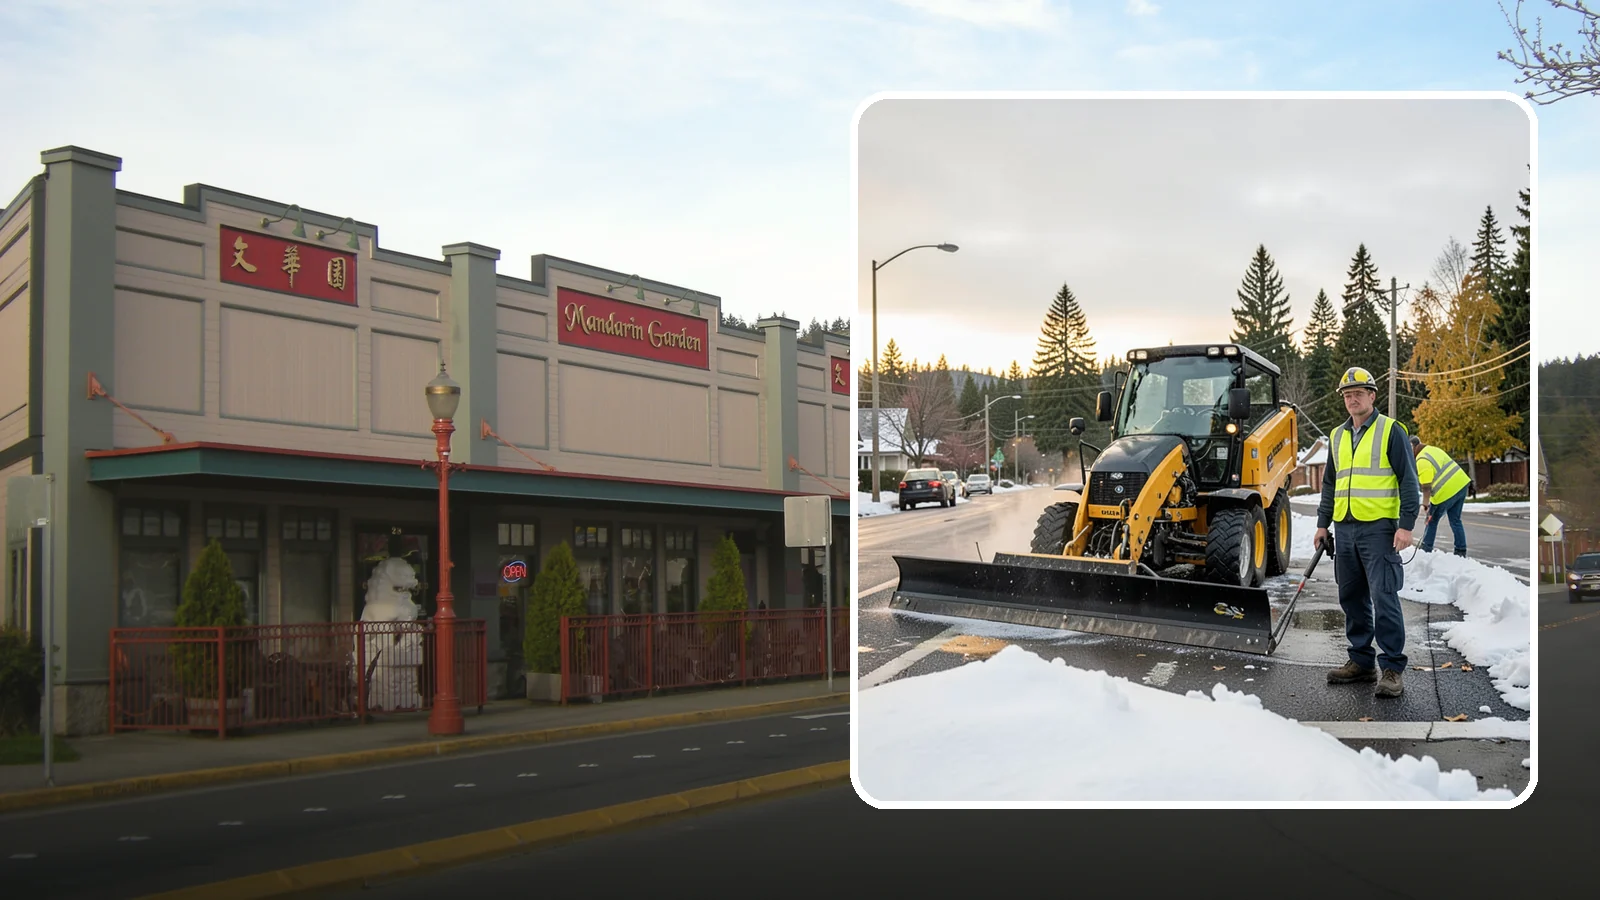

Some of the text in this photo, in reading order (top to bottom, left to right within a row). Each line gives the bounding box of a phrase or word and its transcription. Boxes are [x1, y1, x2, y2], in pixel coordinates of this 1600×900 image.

[230, 235, 346, 291] 文華園
[564, 302, 701, 352] Mandarin Garden
[834, 363, 847, 387] 文
[503, 564, 527, 578] OPEN
